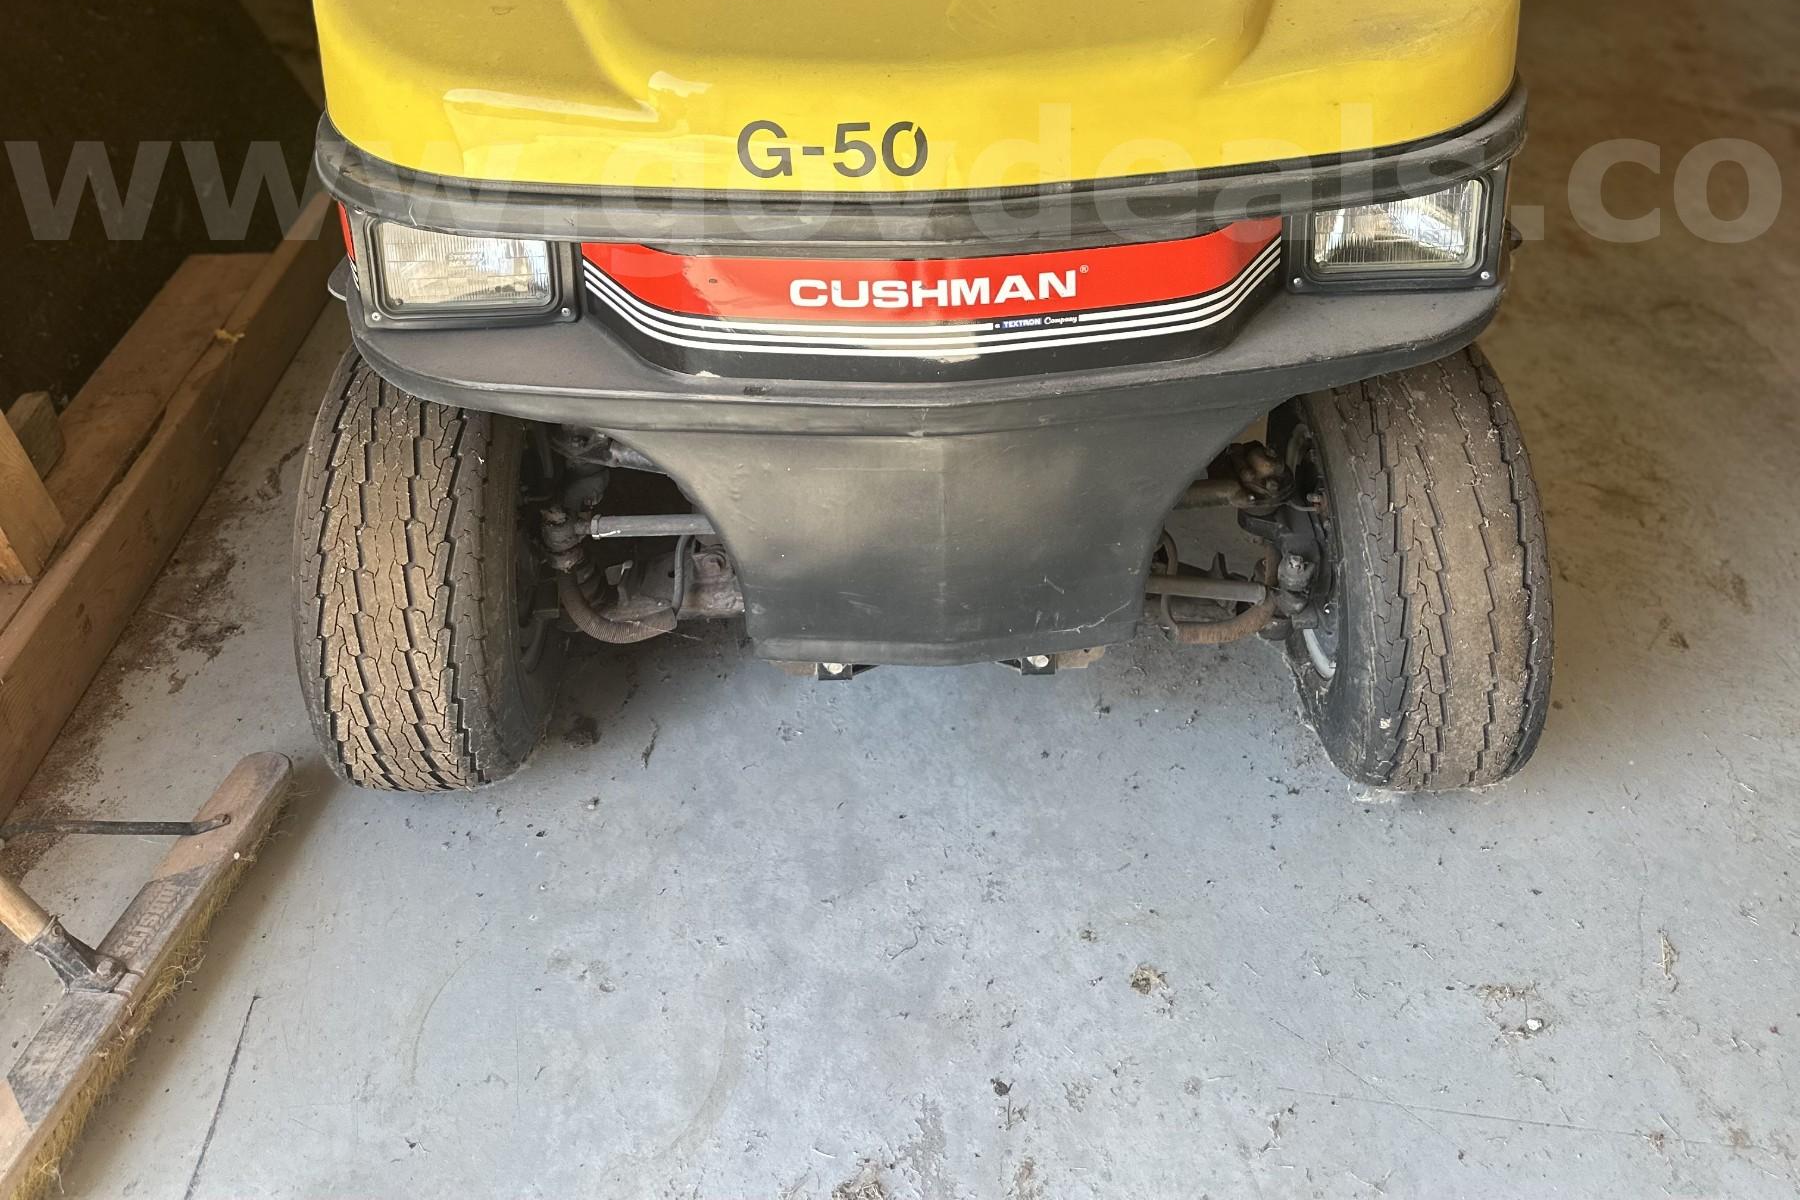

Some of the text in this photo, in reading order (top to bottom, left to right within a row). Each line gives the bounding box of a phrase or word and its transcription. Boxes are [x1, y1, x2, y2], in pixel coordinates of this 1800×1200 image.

[737, 120, 928, 178] G-50
[789, 270, 1077, 308] CUSHMAN
[1003, 318, 1042, 329] TEXTRON
[1044, 316, 1078, 325] Company
